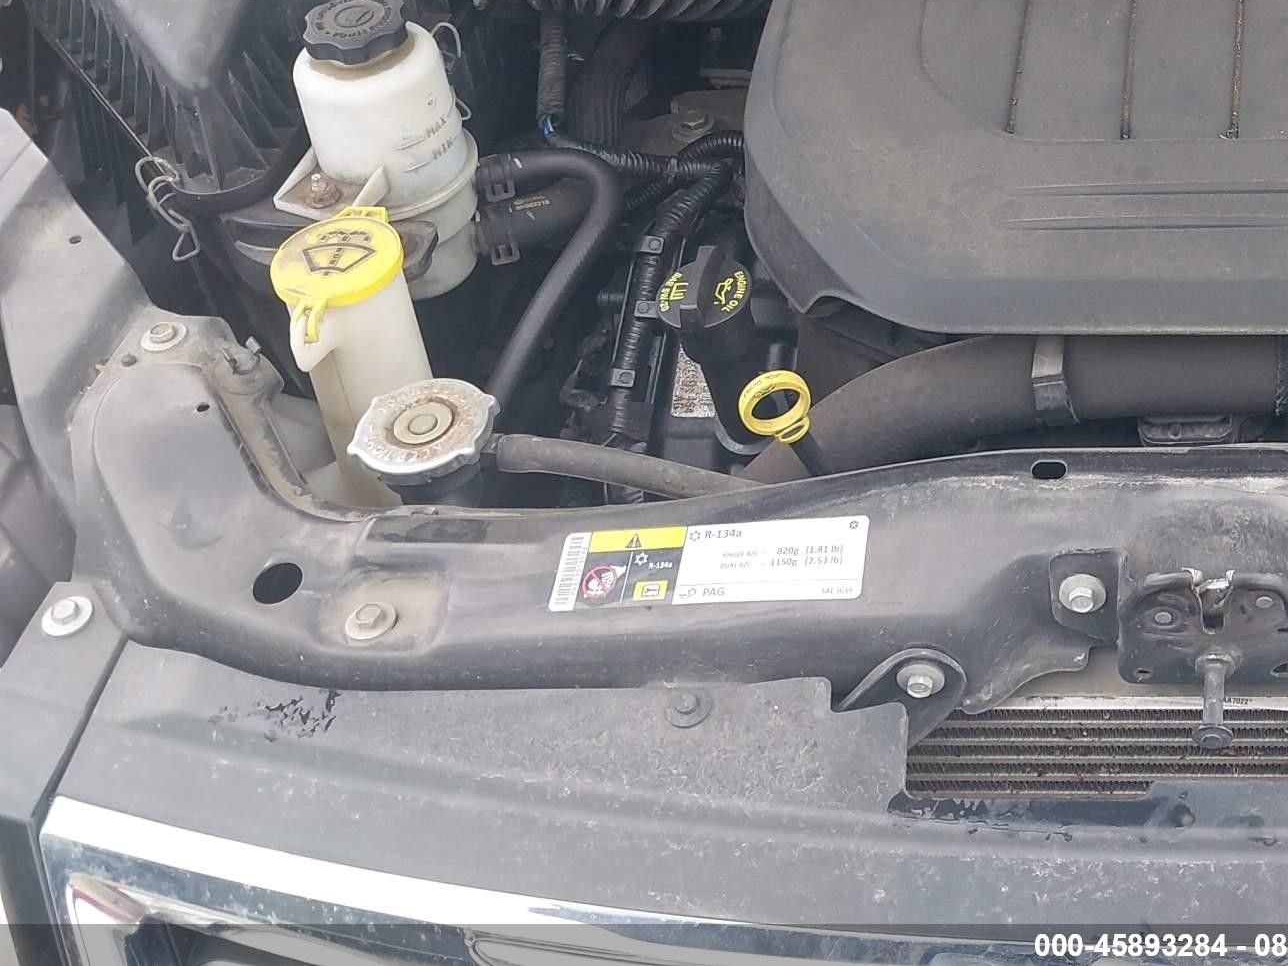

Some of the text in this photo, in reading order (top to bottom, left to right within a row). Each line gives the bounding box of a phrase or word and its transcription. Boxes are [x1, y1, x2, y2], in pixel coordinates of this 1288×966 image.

[426, 115, 447, 138] MAX
[665, 272, 683, 287] SAE
[721, 271, 747, 312] ENGINE OIL
[704, 529, 742, 539] R-134a
[776, 547, 799, 557] 820g
[805, 545, 828, 556] (1.81
[830, 544, 844, 555] lb)
[770, 557, 798, 567] 1150g
[804, 556, 828, 567] (2.53
[830, 555, 843, 566] lb)
[702, 587, 726, 597] PAG
